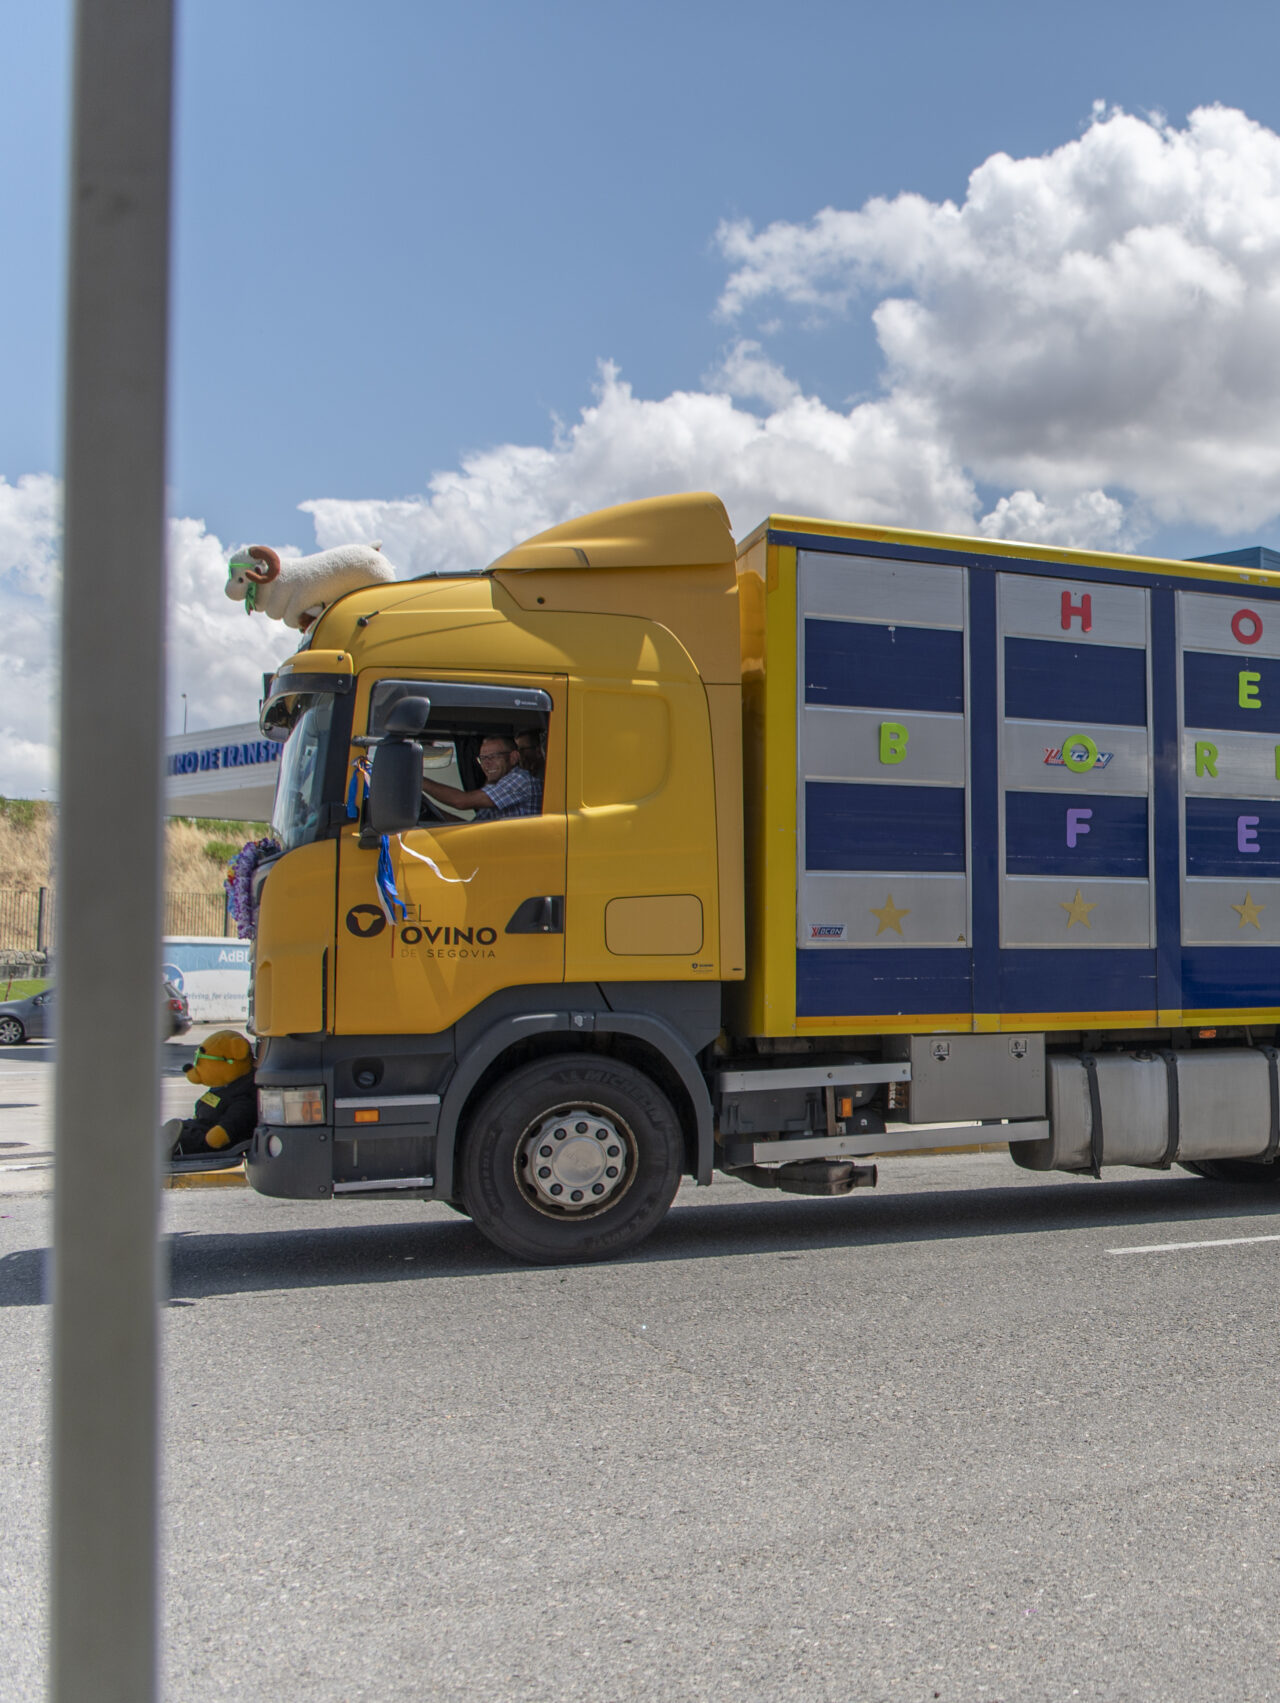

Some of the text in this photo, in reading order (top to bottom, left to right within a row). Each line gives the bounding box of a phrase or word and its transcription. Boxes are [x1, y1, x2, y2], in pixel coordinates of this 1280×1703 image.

[200, 748, 220, 771] DE
[402, 904, 432, 922] EL
[400, 926, 498, 945] OVINO
[401, 950, 496, 958] DE SEGOVIA
